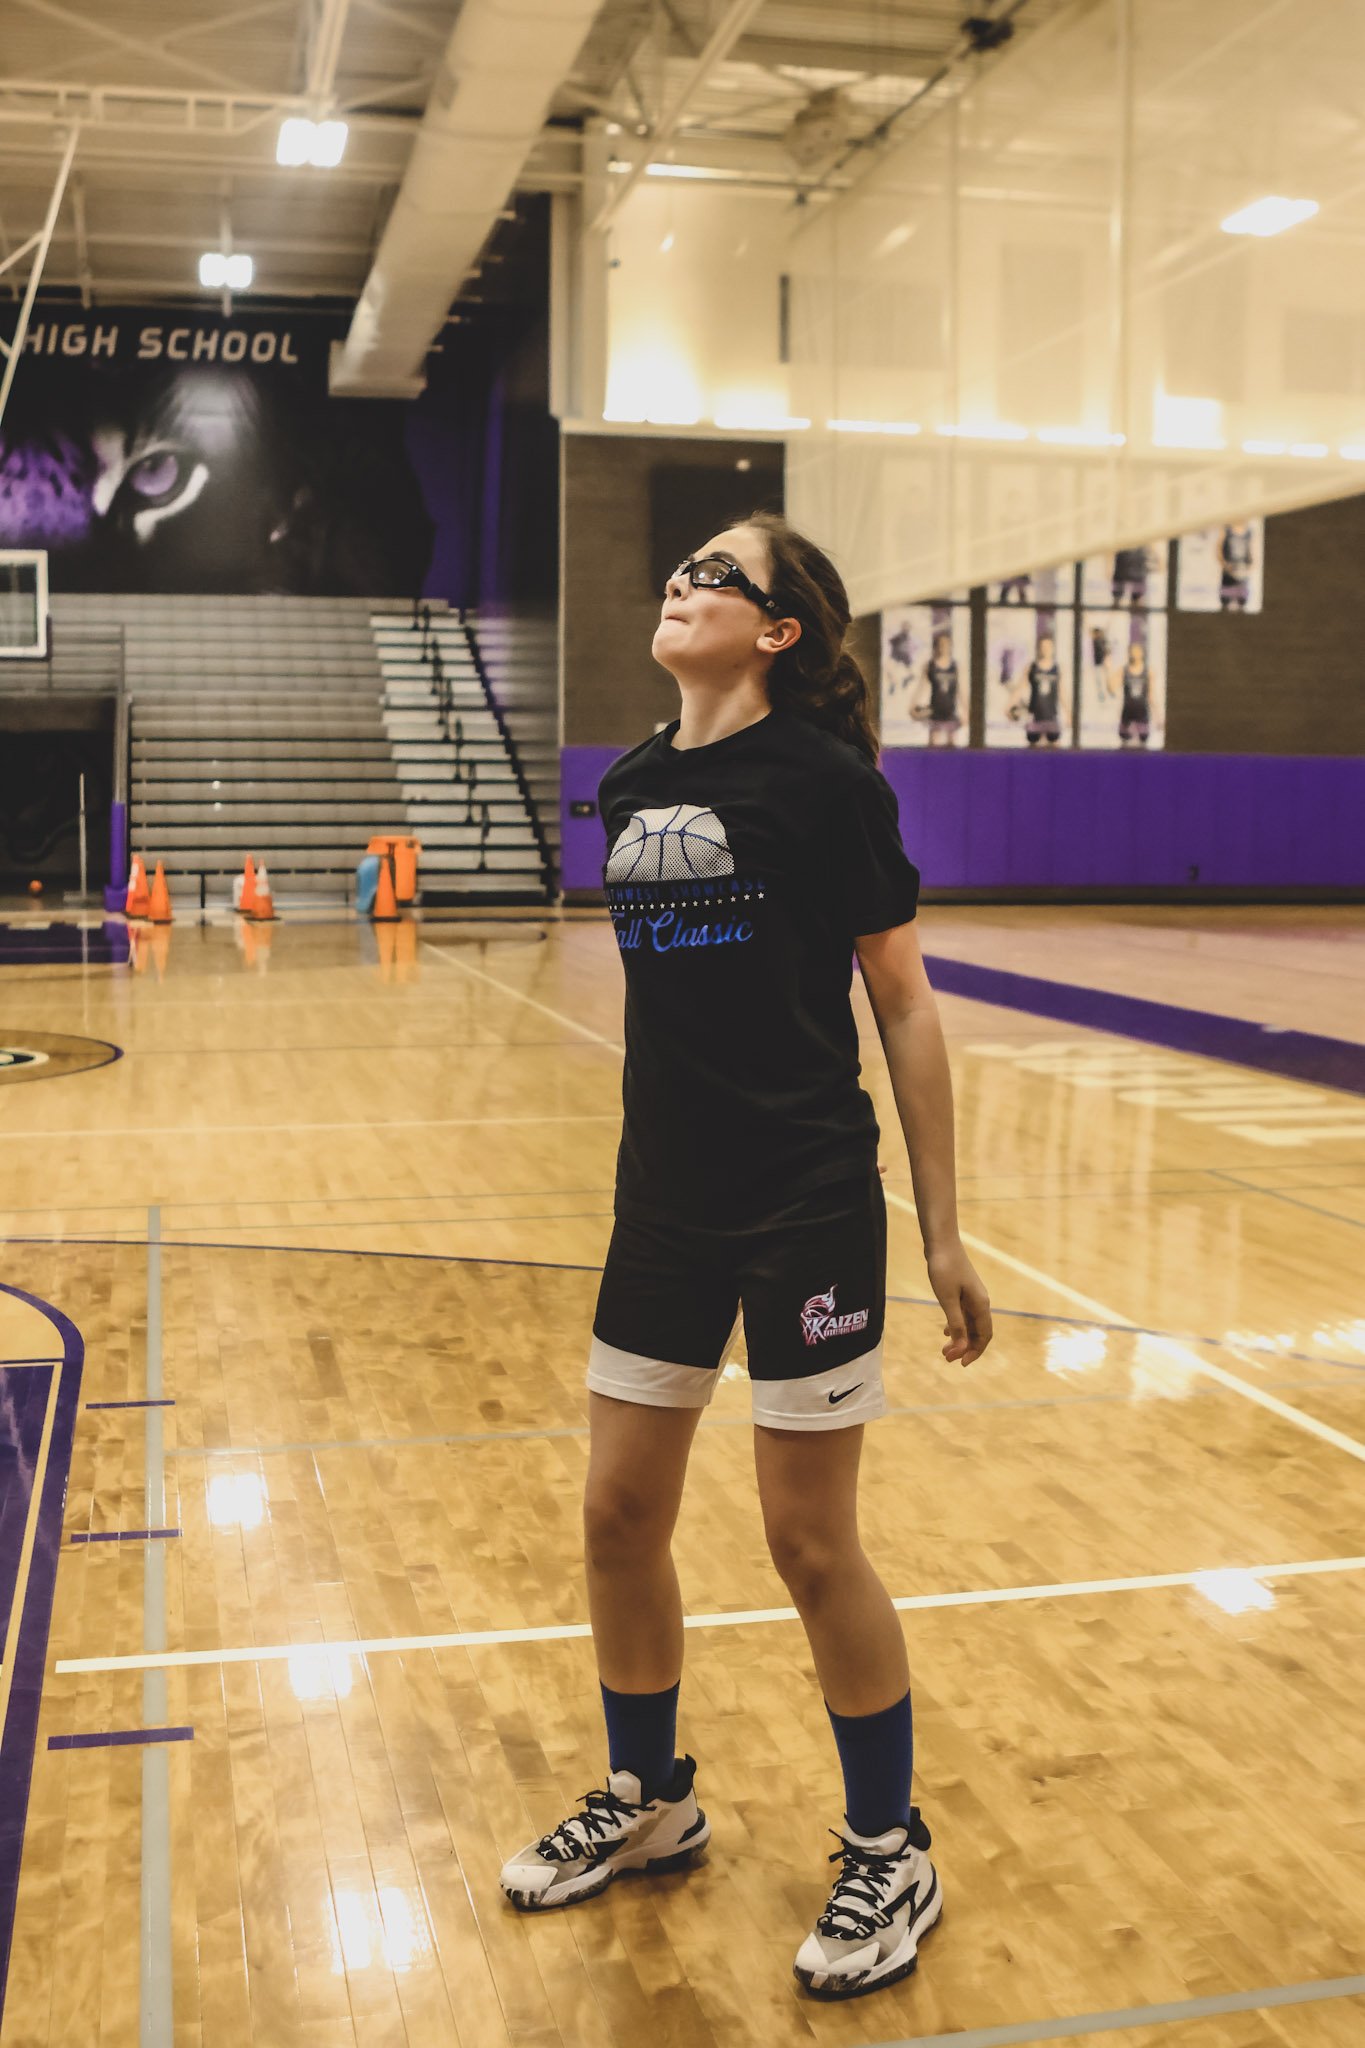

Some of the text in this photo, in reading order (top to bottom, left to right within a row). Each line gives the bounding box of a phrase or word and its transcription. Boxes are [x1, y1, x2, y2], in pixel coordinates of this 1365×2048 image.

[22, 323, 299, 365] HIGH SCHOOL
[645, 910, 754, 953] Classic
